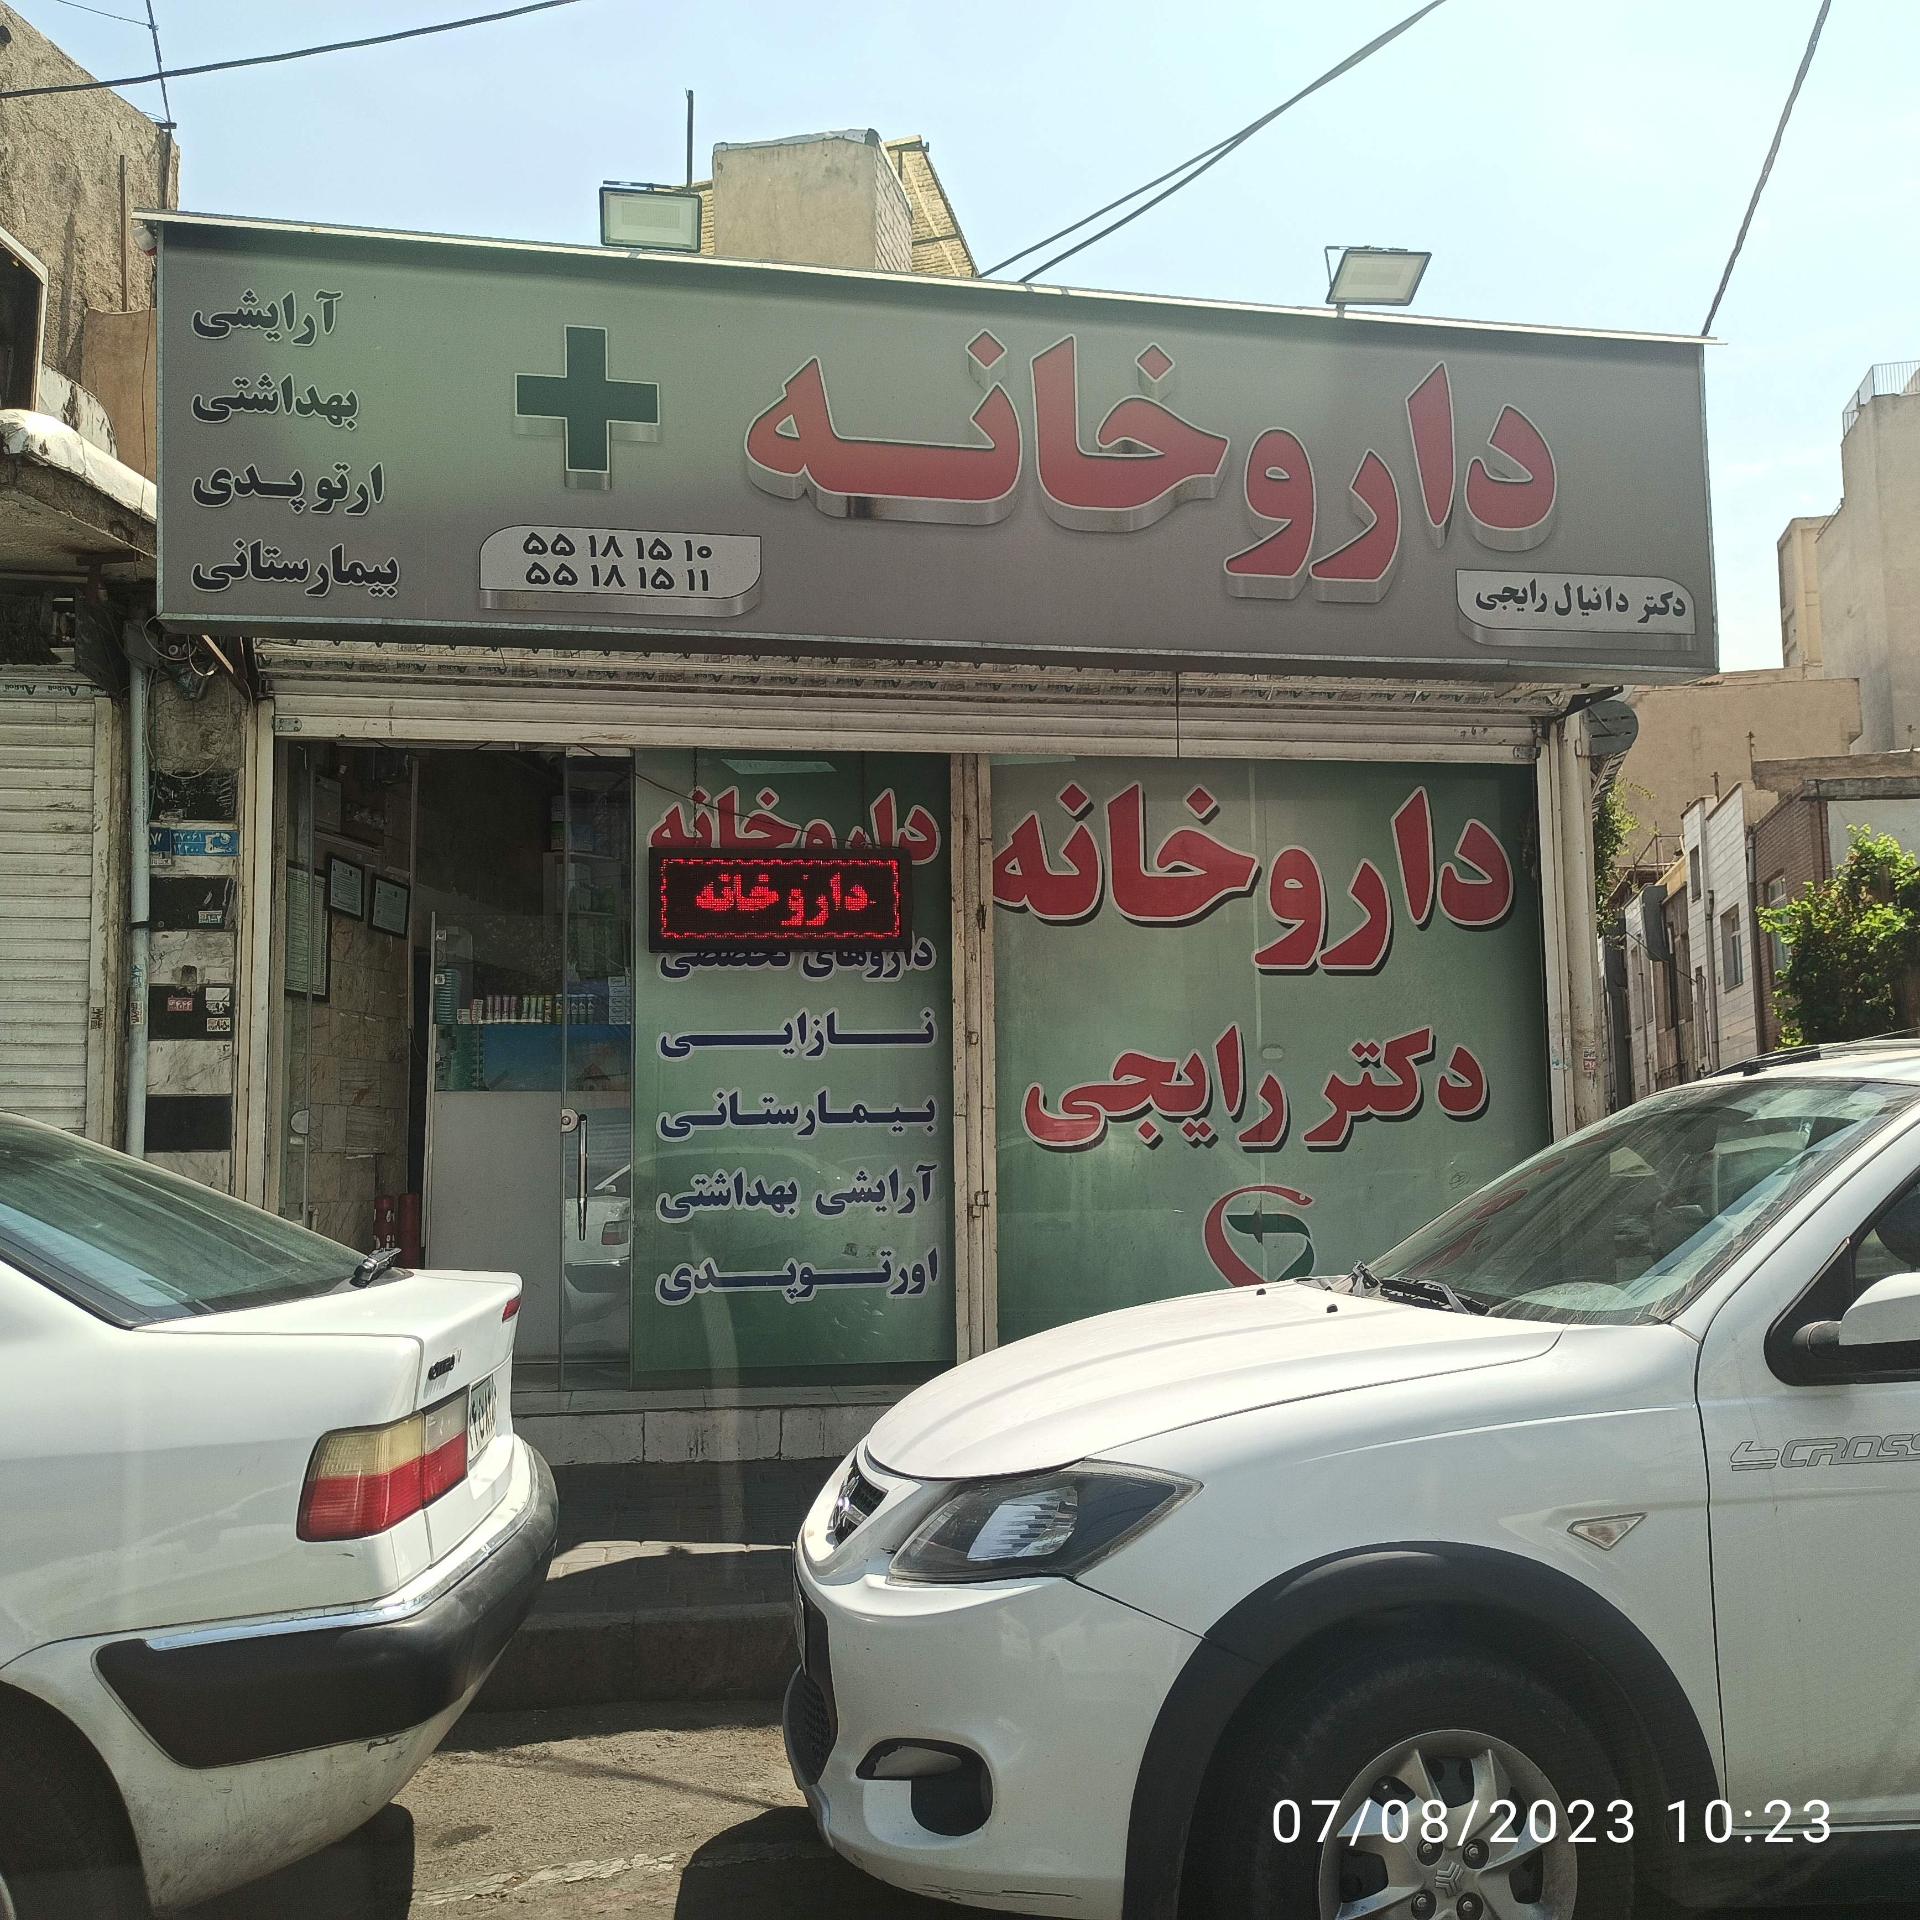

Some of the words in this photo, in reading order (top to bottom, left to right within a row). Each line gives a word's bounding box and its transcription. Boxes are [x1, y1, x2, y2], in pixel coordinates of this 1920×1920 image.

[192, 288, 343, 346] آرایشی
[191, 373, 359, 430] بهداشتی
[744, 328, 1558, 584] داروخانه
[191, 538, 399, 597] بیمارستانی
[1475, 578, 1548, 612] رایجی
[1554, 582, 1629, 616] دانیال
[1637, 591, 1686, 623] دکتر
[992, 782, 1512, 970] داروخانه
[659, 1009, 936, 1058] نازایی
[1021, 1024, 1288, 1147] رایجی
[1304, 1026, 1488, 1147] دکتر
[659, 1089, 936, 1139] بیمارستانی
[659, 1169, 799, 1220] بهداشتی
[815, 1163, 938, 1215] آرایشی
[658, 1247, 939, 1301] اورتوپدی
